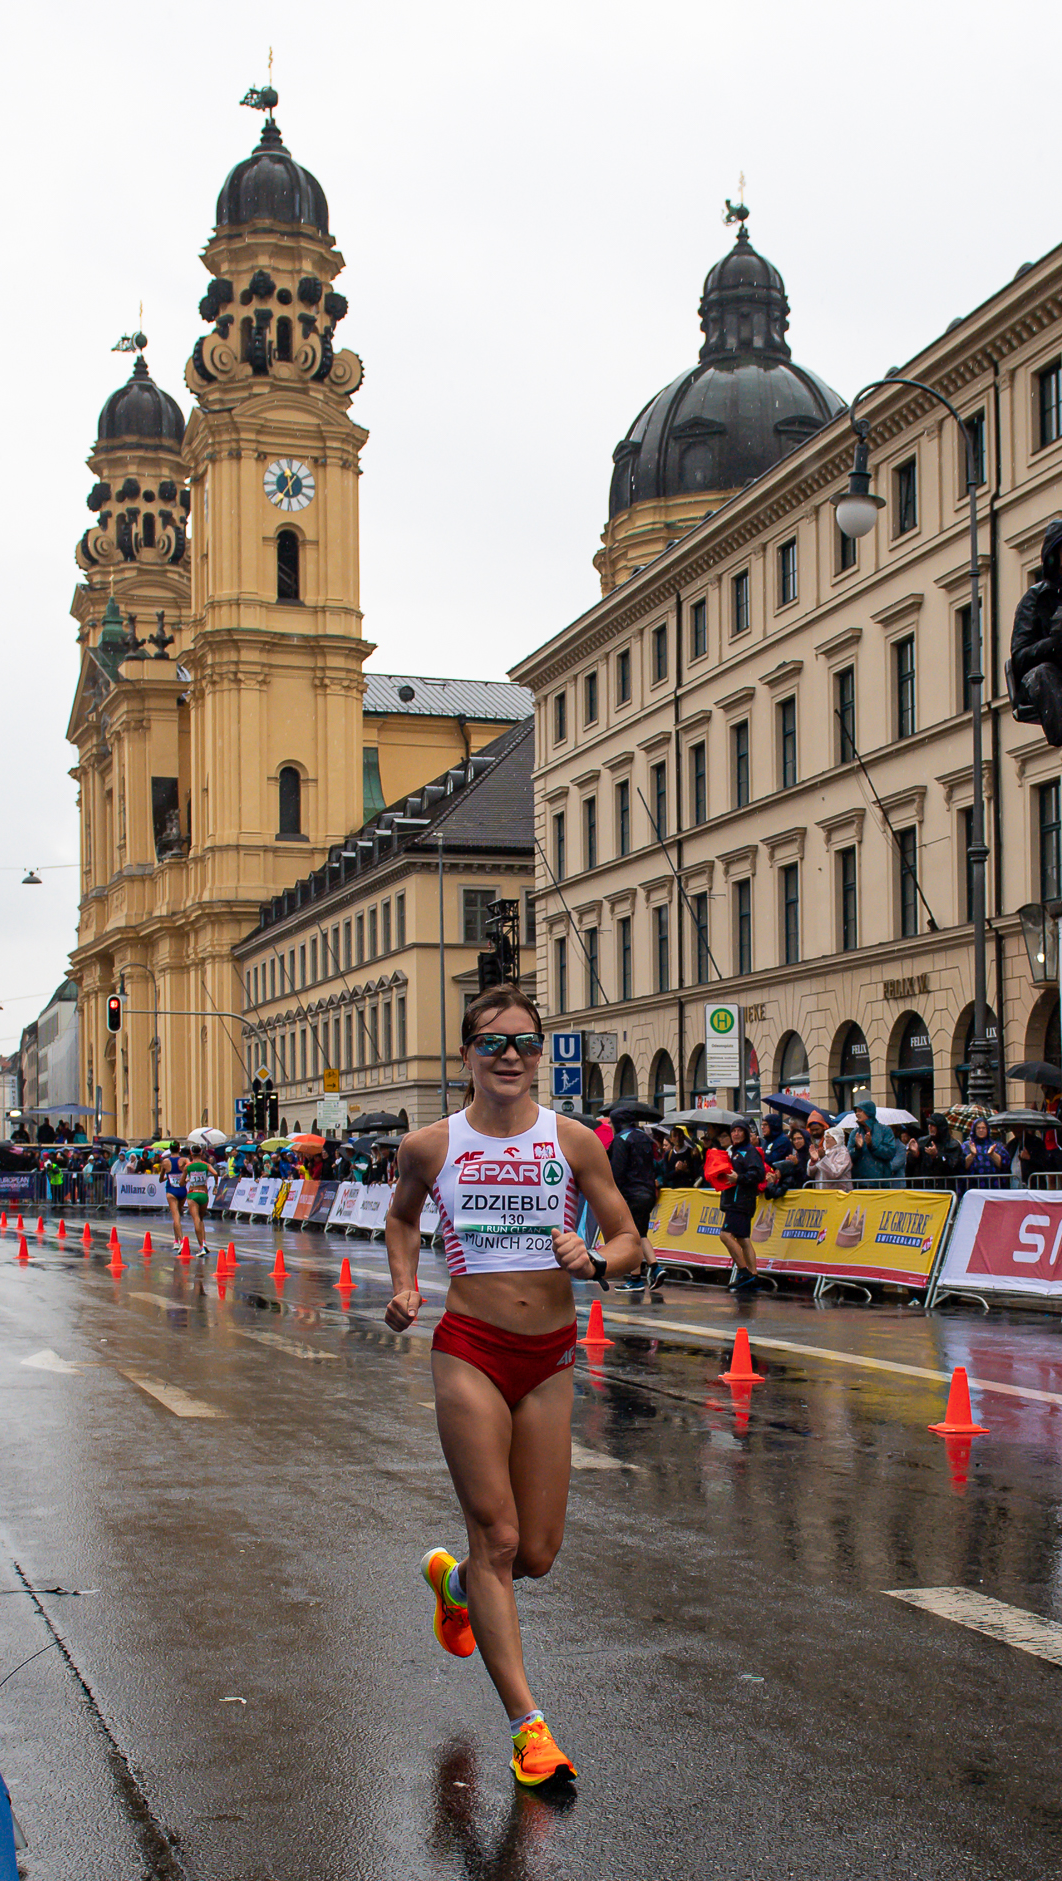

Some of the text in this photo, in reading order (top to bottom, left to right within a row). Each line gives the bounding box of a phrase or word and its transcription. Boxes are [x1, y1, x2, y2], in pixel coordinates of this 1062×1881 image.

[883, 976, 916, 999] FELIX
[717, 1014, 727, 1028] H
[986, 1027, 996, 1038] LIX
[559, 1037, 575, 1058] U
[910, 1035, 928, 1047] FELIX
[851, 1044, 867, 1055] FELIX
[461, 1163, 539, 1183] SPAR
[120, 1184, 146, 1194] Allianz
[461, 1194, 559, 1211] ZDZIEBLO
[500, 1213, 525, 1225] 130
[699, 1206, 710, 1223] LE
[785, 1209, 796, 1227] LE
[878, 1210, 892, 1231] LE
[486, 1225, 508, 1233] RUN
[782, 1230, 818, 1239] SWITZERLAND
[464, 1233, 553, 1251] MUNICH 202
[876, 1234, 921, 1247] SWITZERLAND
[1012, 1213, 1062, 1266] S
